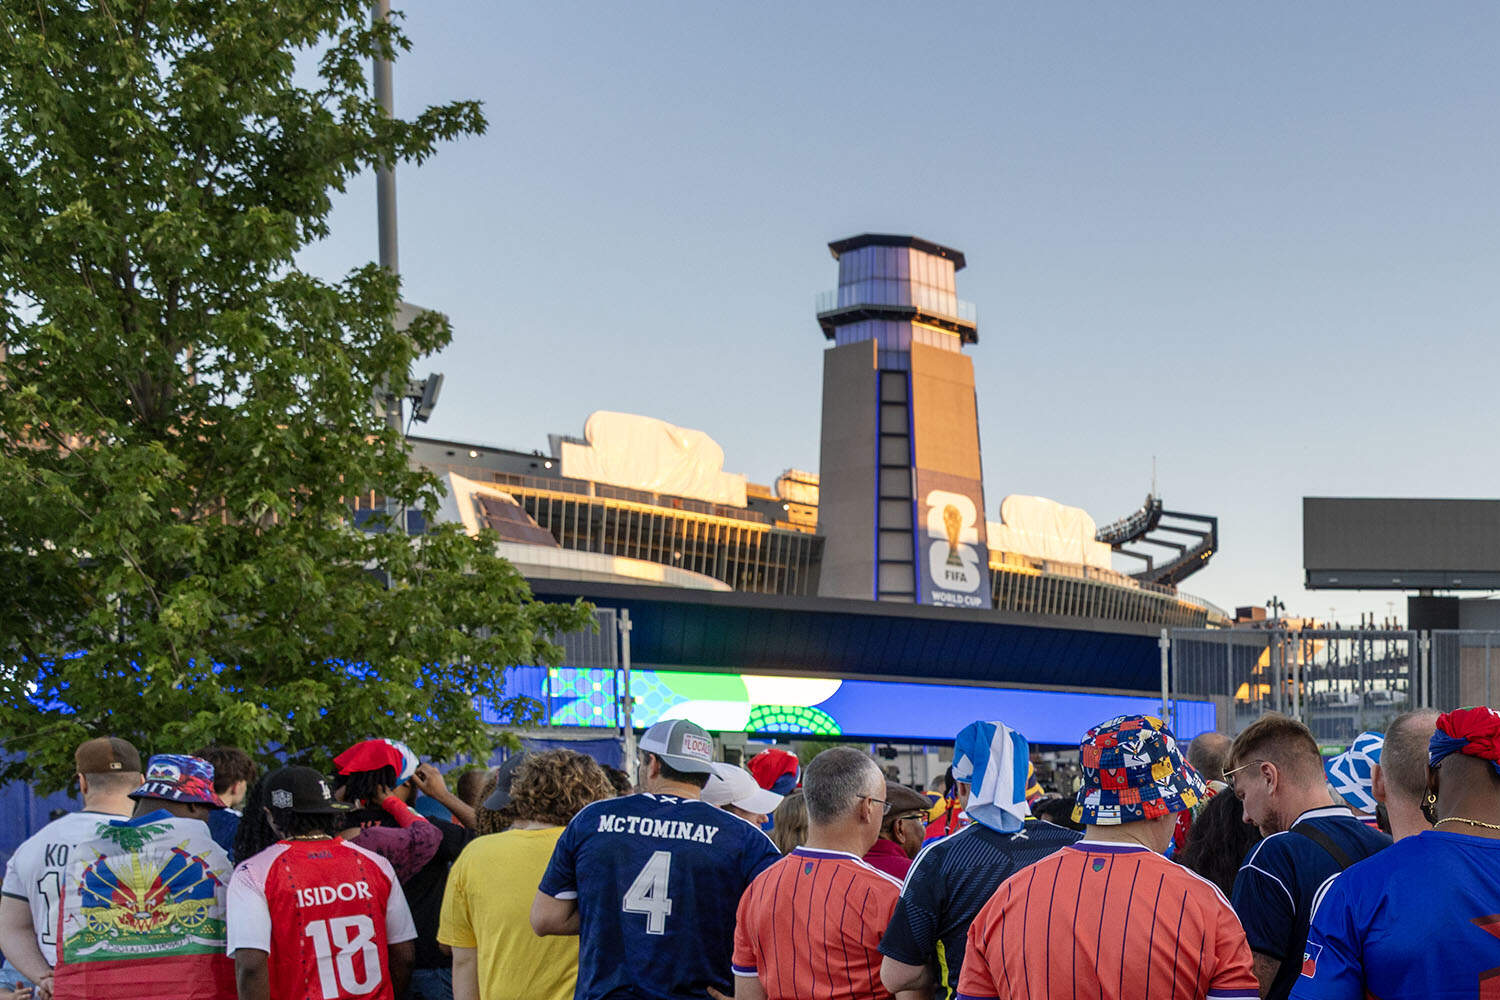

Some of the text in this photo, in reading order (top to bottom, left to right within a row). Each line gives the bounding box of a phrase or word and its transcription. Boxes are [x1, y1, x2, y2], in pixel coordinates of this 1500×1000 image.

[944, 570, 968, 583] FIFA
[931, 590, 963, 604] WORLD
[964, 595, 983, 607] CUP
[597, 814, 719, 845] McTOMINAY
[45, 843, 78, 867] KO
[296, 880, 373, 908] ISIDOR
[622, 850, 673, 935] 4
[305, 915, 383, 1000] 18
